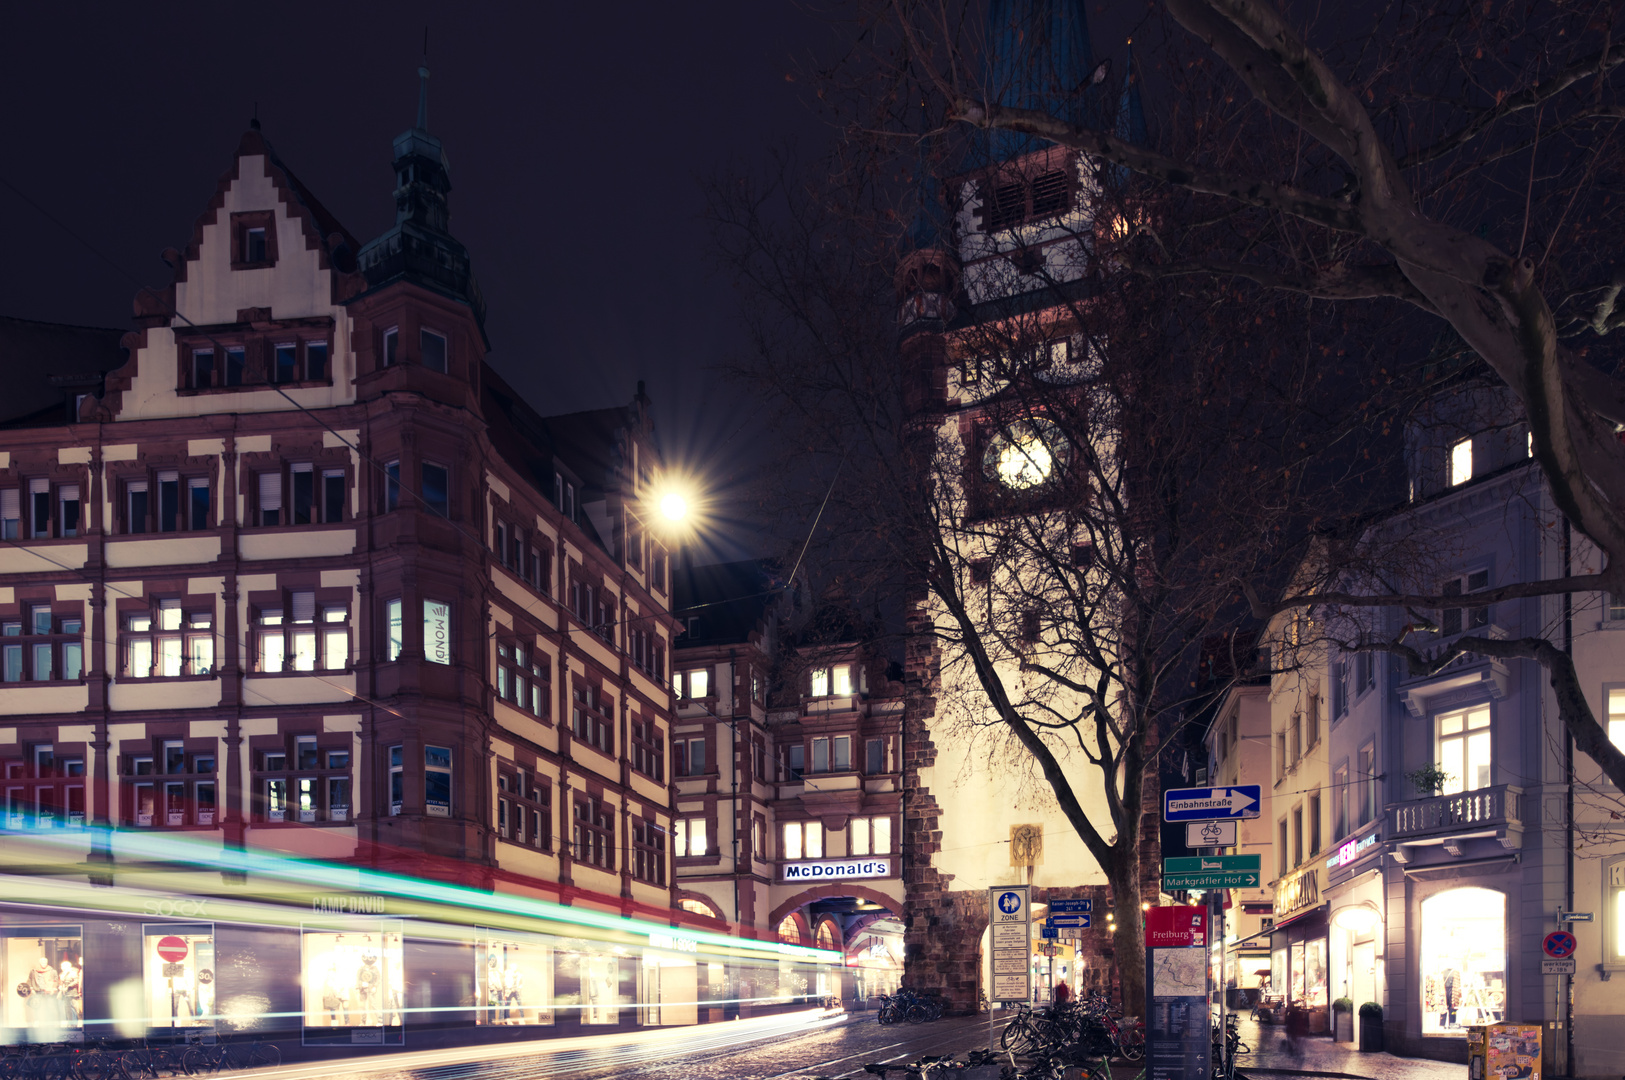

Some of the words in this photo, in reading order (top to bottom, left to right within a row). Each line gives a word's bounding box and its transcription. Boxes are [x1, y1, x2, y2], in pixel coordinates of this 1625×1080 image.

[1170, 798, 1233, 809] Einbahnstraße
[786, 861, 886, 877] McDonald's
[1166, 876, 1221, 888] Markgräfler
[1224, 875, 1242, 884] Hof
[313, 896, 347, 914] CAMP
[349, 895, 385, 913] DAVID
[1152, 930, 1189, 940] Freiburg
